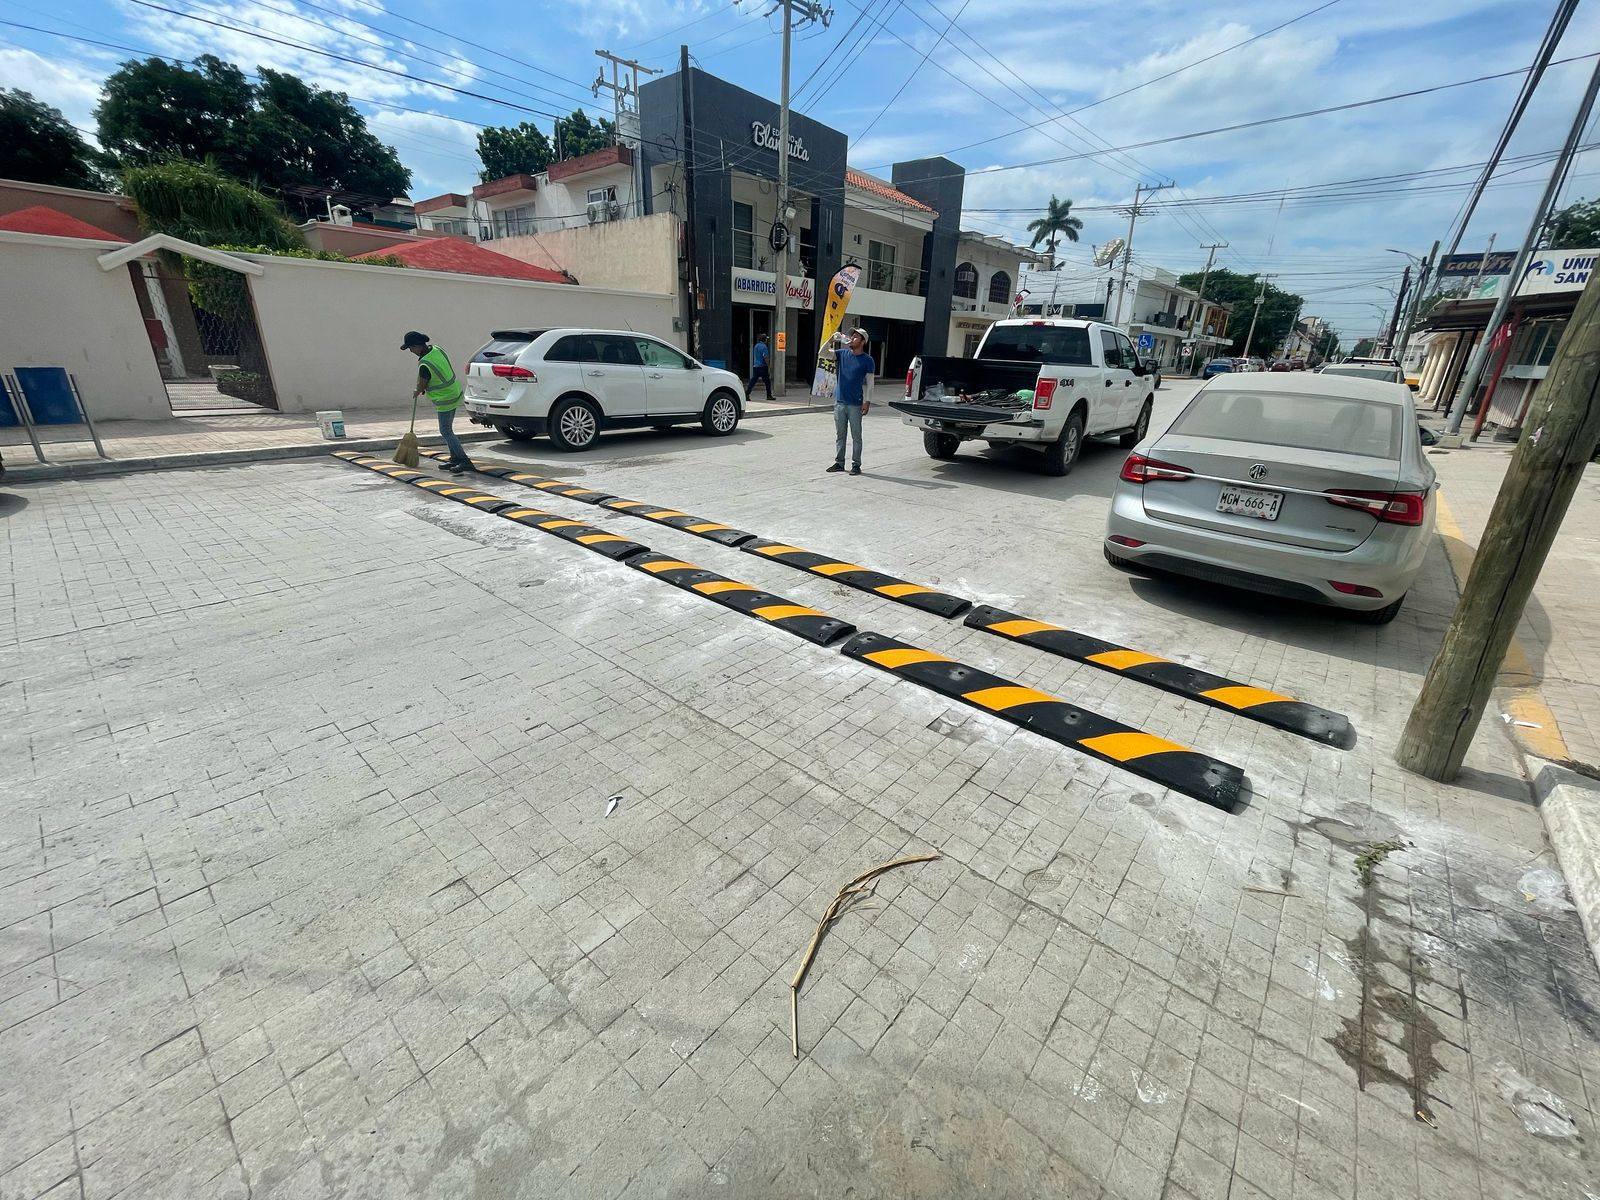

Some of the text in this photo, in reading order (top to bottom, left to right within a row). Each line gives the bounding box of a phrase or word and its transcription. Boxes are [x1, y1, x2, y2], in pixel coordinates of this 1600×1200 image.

[1562, 257, 1597, 269] UNI
[736, 277, 776, 294] ABARROTES
[1219, 492, 1278, 512] MGW-666-A
